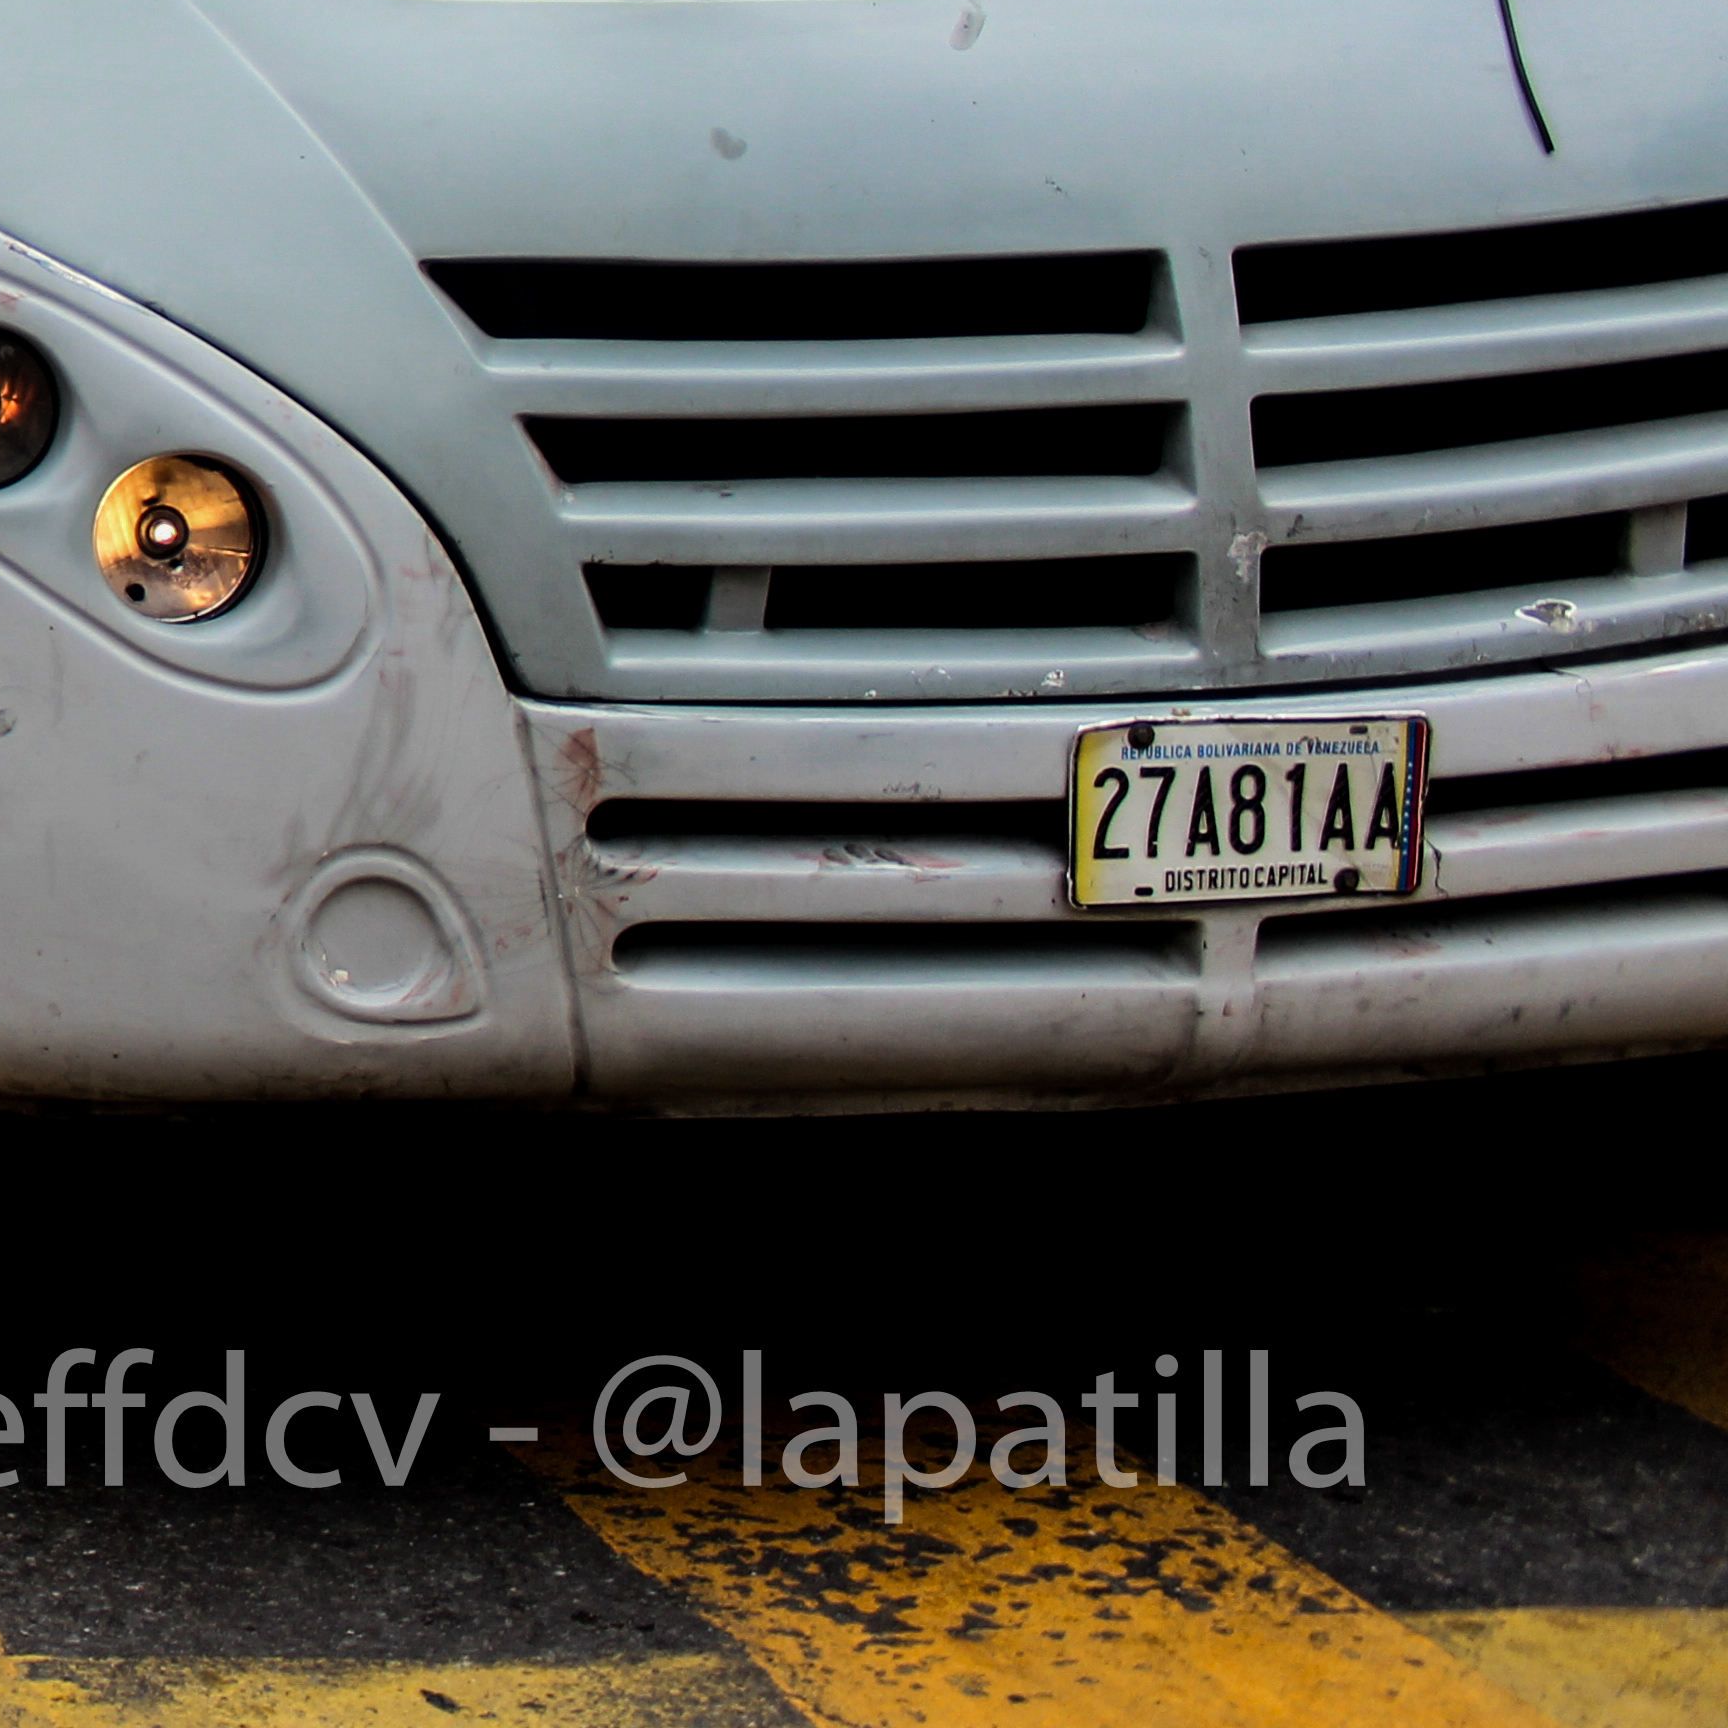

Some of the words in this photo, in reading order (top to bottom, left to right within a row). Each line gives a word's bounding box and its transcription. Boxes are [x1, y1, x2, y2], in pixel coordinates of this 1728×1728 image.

[1197, 742, 1281, 759] BOLIVARIANA
[1286, 741, 1302, 757] DE
[1307, 740, 1380, 756] VENEZUELA
[1092, 761, 1402, 860] 27A81AA
[1165, 867, 1250, 893] DISTRITO
[1254, 861, 1328, 887] CAPITAL
